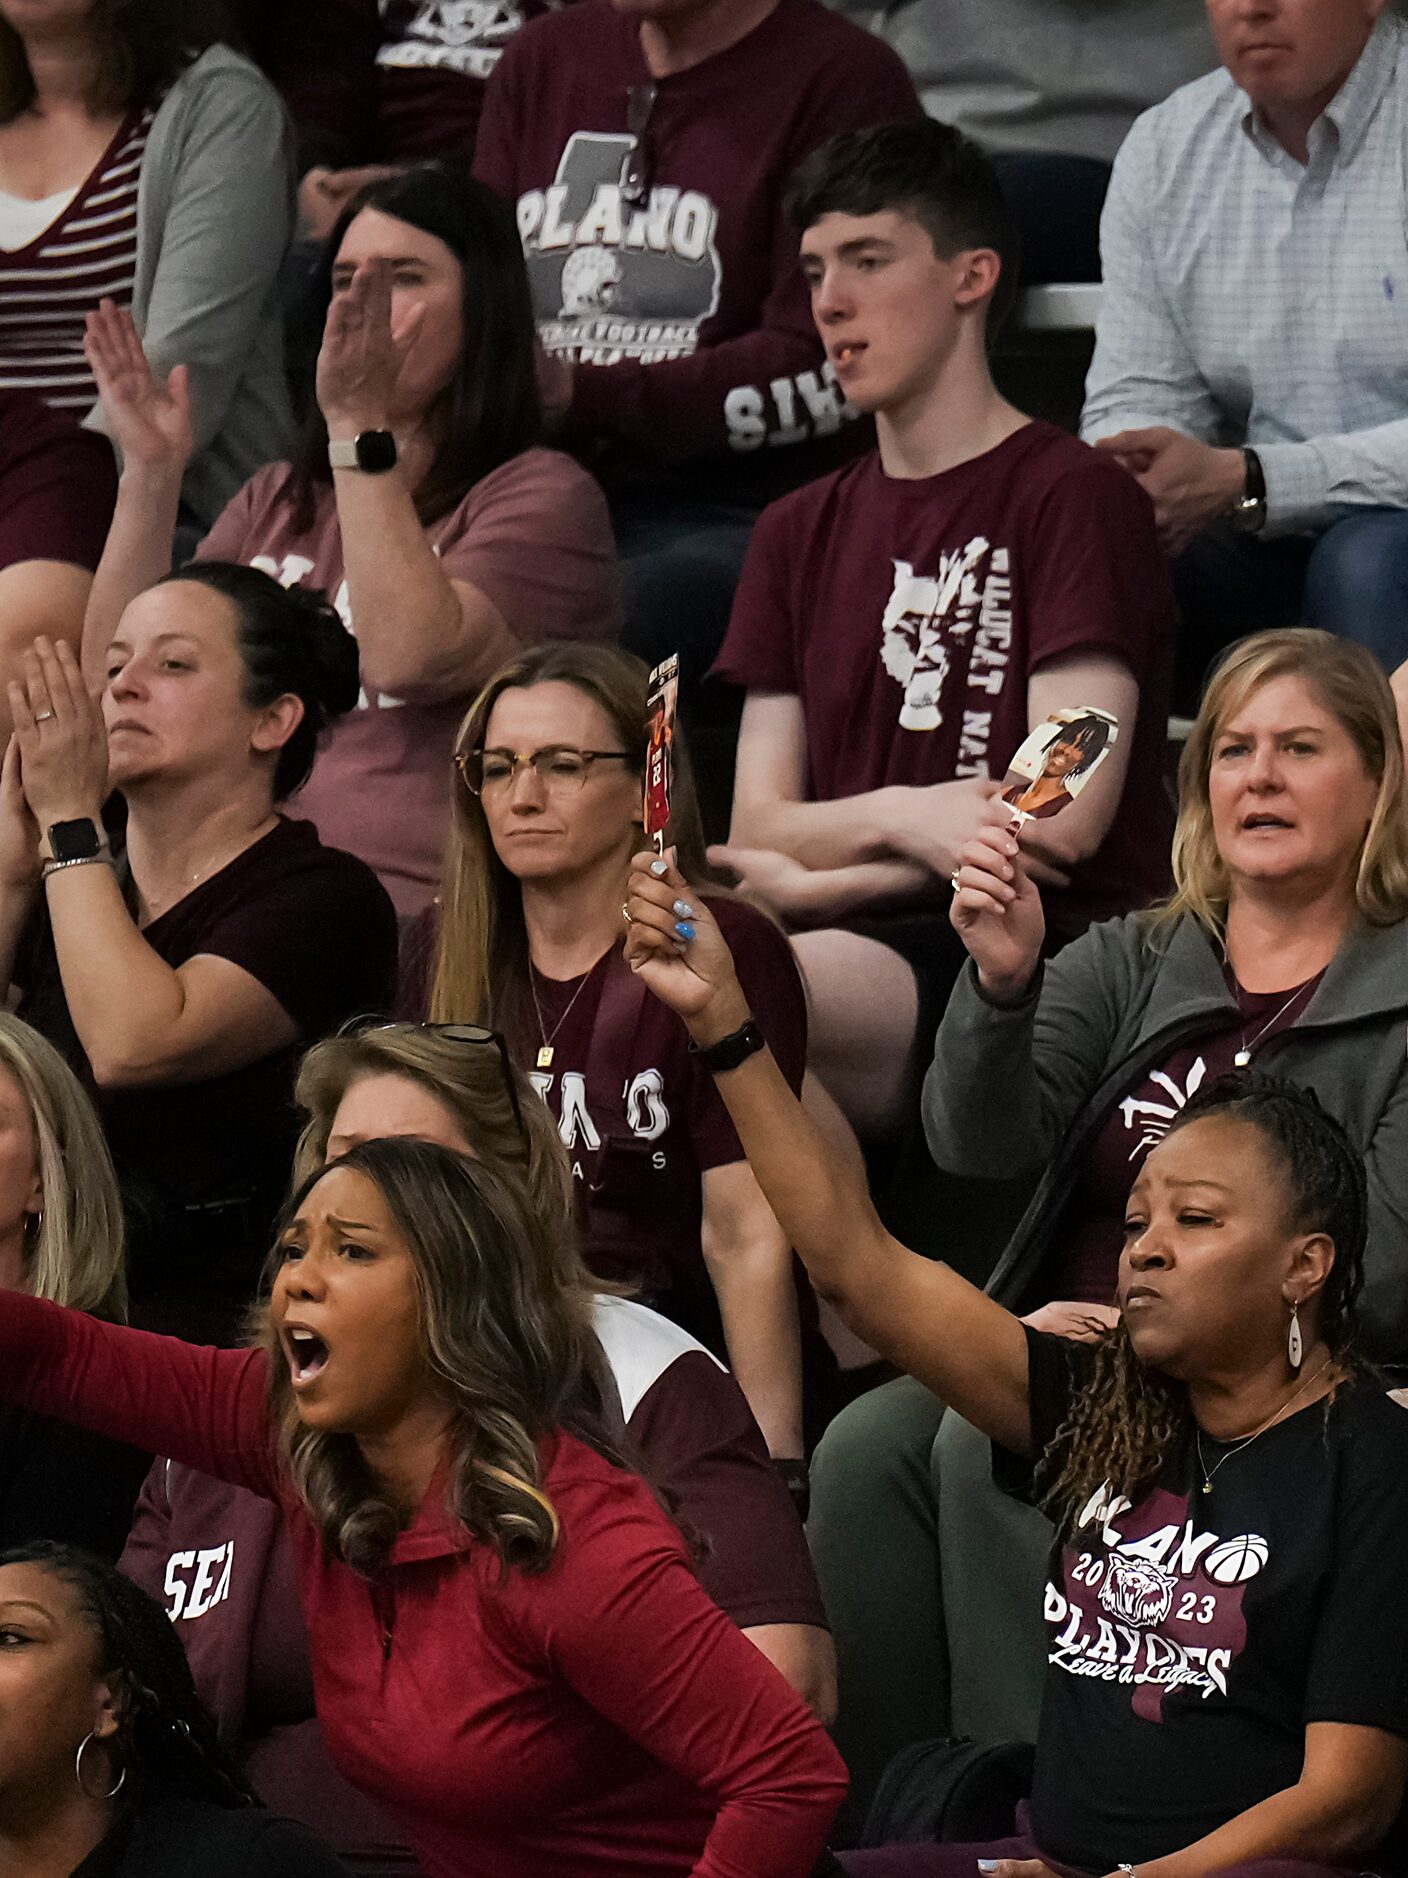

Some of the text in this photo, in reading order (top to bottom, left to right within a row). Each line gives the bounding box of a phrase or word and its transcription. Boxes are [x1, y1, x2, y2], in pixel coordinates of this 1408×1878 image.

[516, 183, 711, 260] PLANO
[1071, 1553, 1216, 1624] 20 23
[1048, 1644, 1117, 1681] Leave
[1119, 1668, 1135, 1683] a
